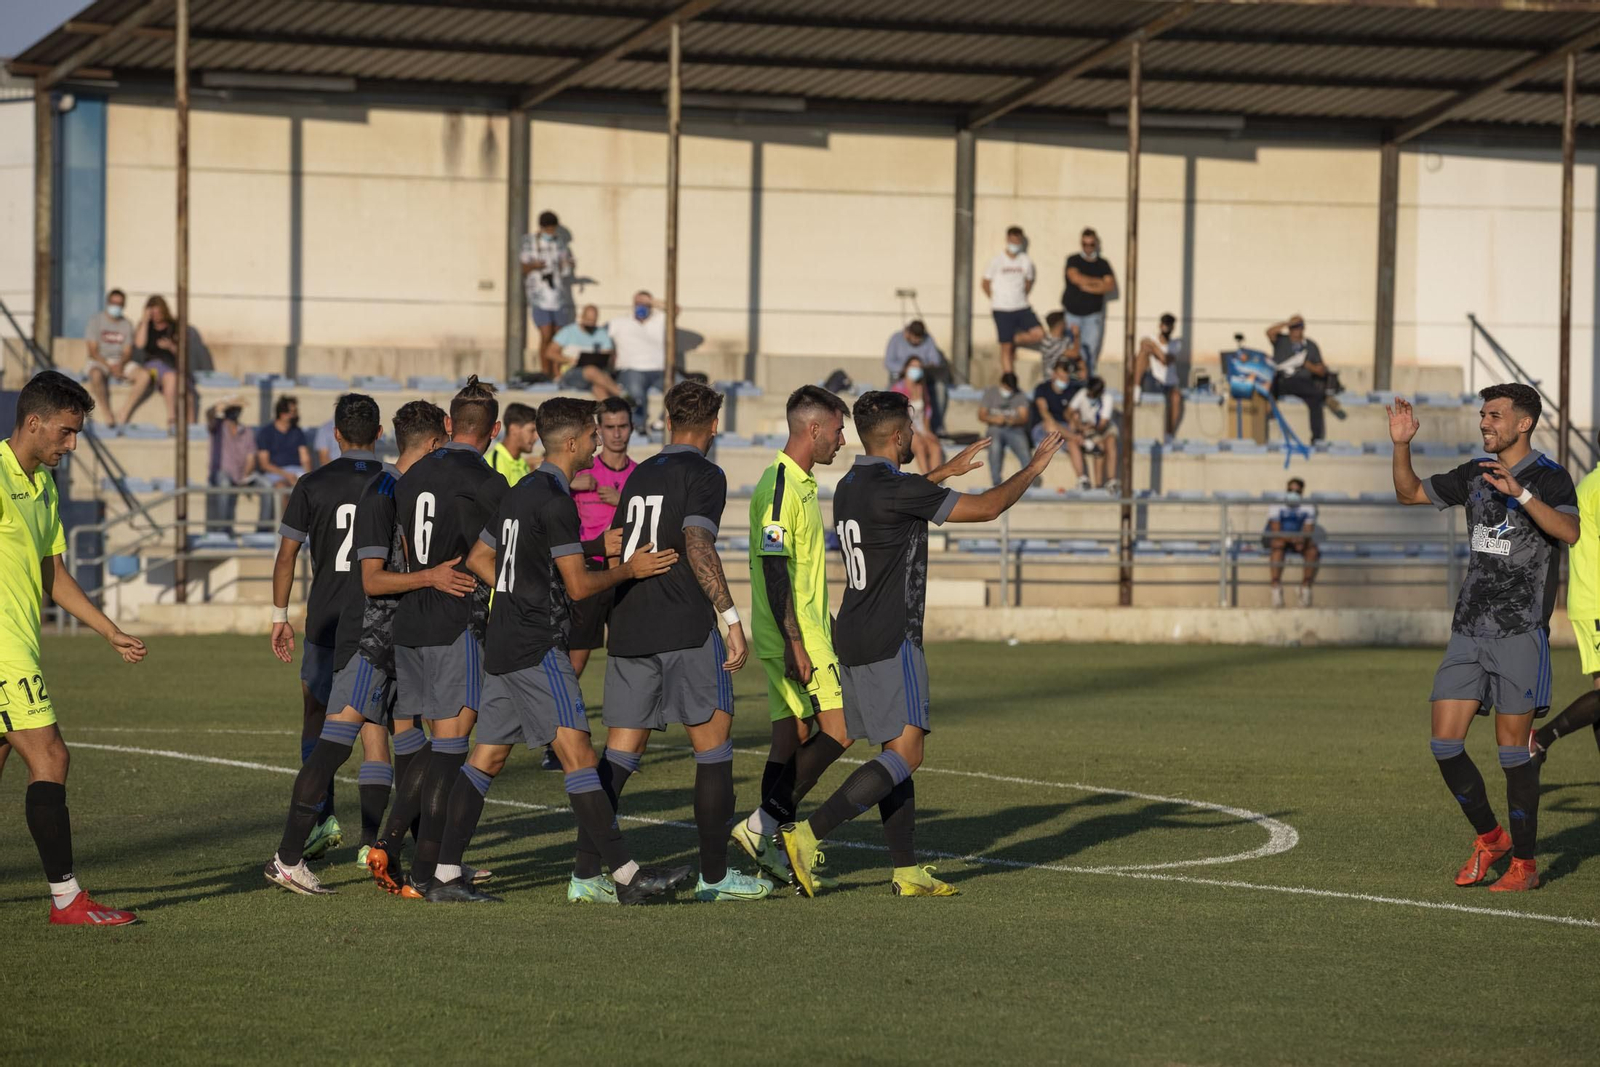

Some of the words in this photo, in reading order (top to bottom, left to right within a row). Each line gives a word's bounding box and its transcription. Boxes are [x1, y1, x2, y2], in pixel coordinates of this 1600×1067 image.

[335, 503, 357, 572] 2
[414, 491, 436, 565] 6
[623, 495, 664, 564] 27
[836, 519, 867, 591] 16
[17, 674, 49, 706] 12
